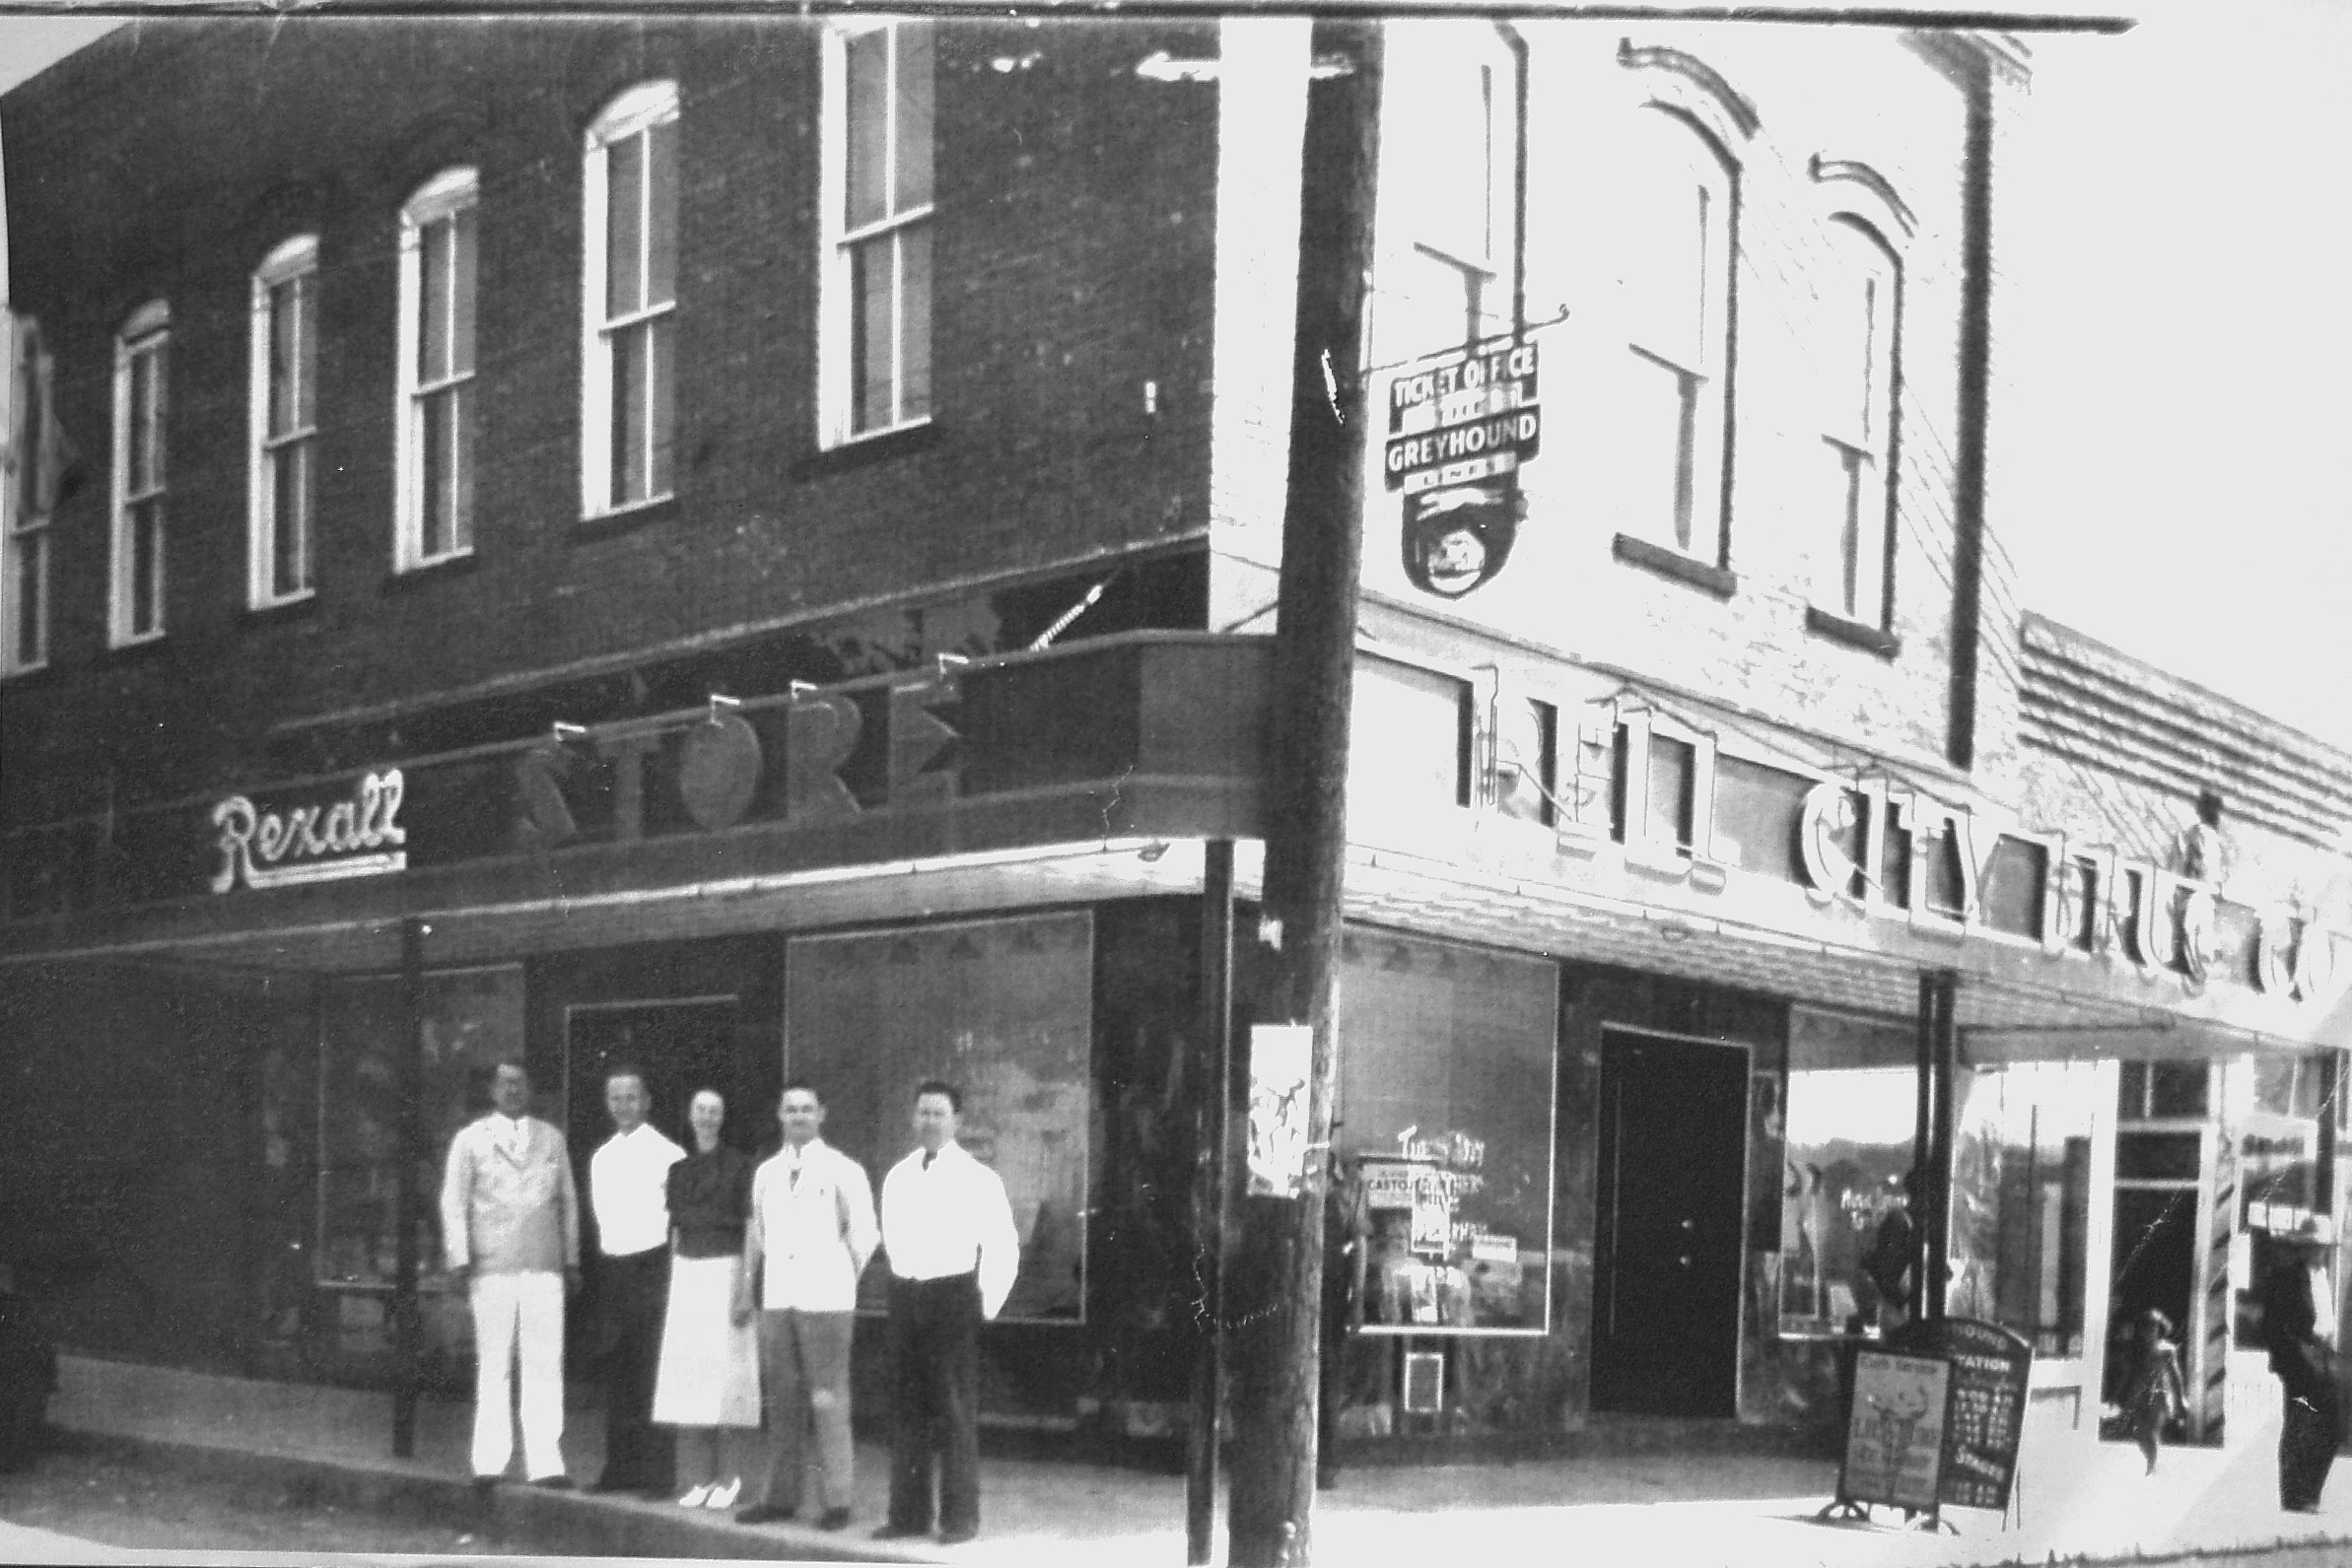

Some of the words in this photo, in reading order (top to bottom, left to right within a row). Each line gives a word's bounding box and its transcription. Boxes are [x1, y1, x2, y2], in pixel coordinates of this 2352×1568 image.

[1395, 367, 1459, 406] TICKET
[1388, 415, 1537, 472] GREYHOUND
[513, 682, 959, 846] STORE
[212, 769, 406, 893] Rexall
[1800, 781, 2001, 931] CITY
[2042, 841, 2218, 995] DRUG
[1954, 1352, 2011, 1373] TATION
